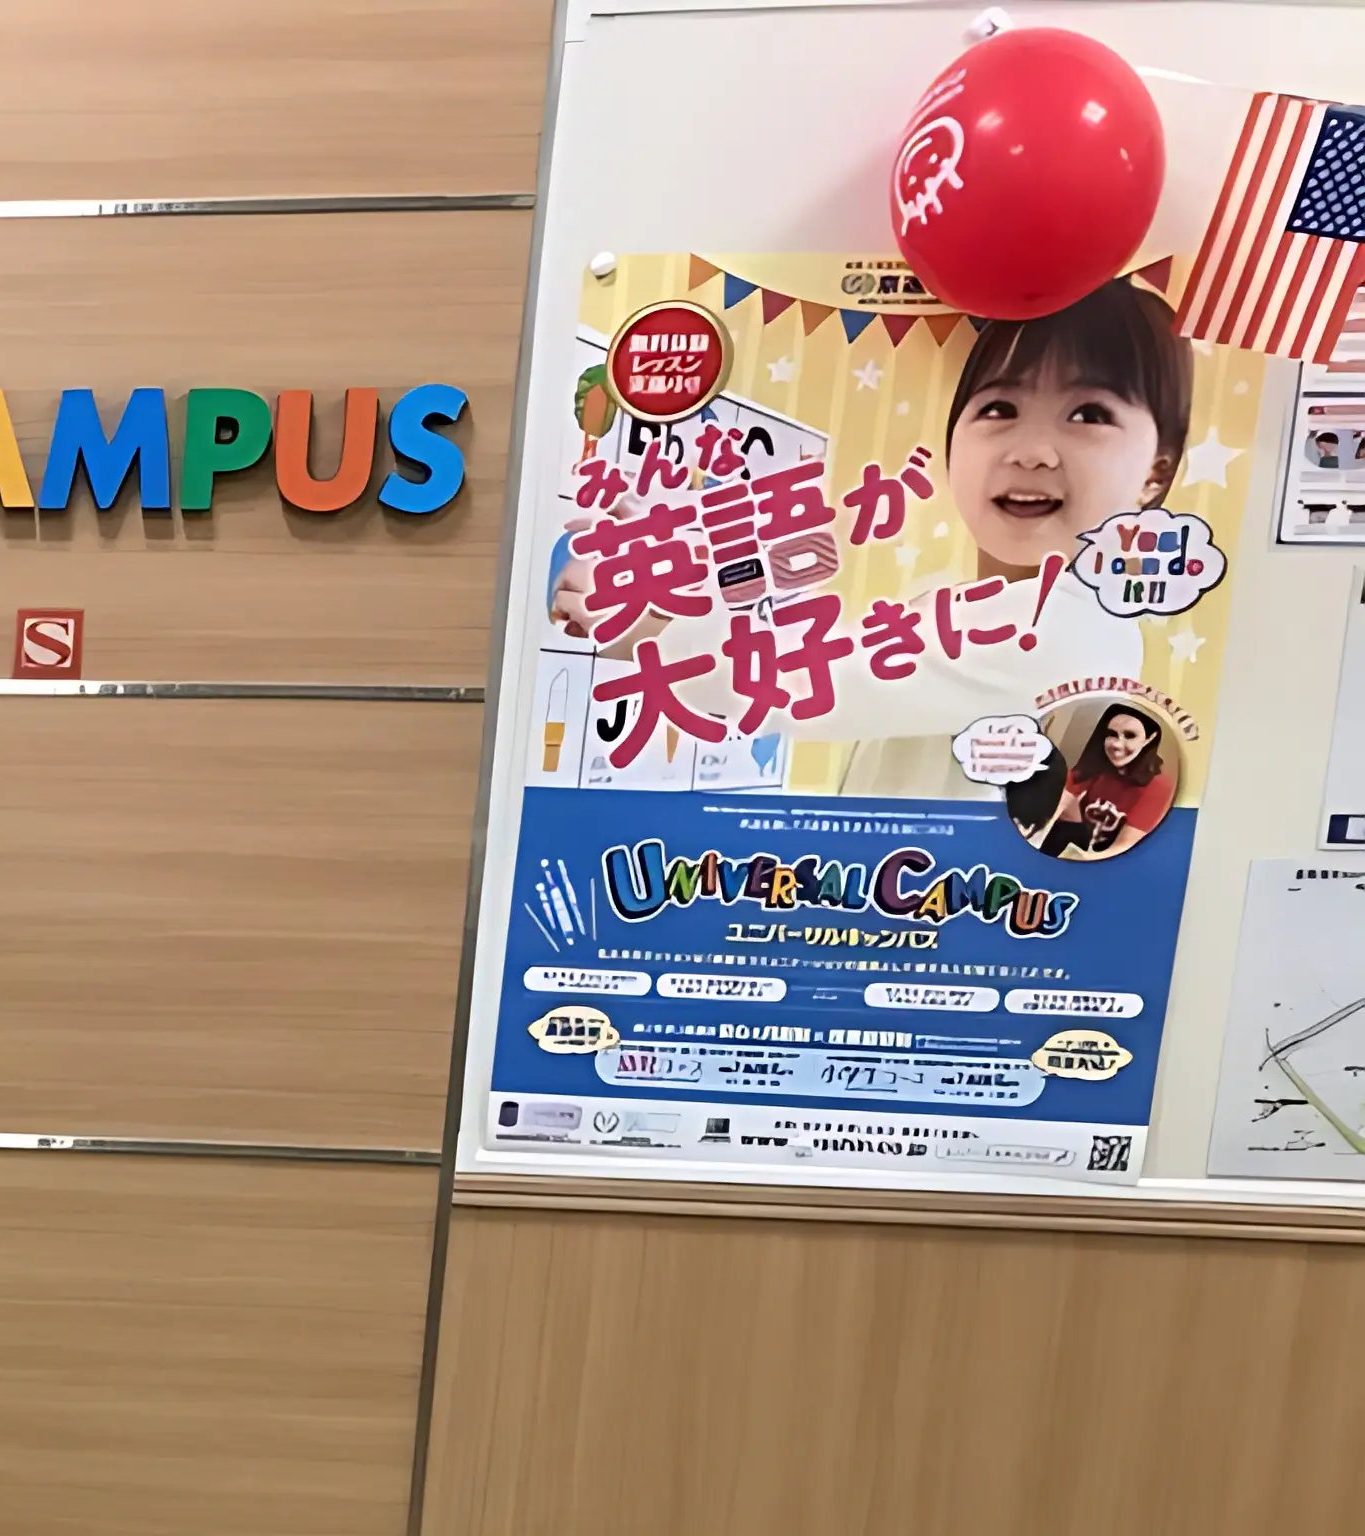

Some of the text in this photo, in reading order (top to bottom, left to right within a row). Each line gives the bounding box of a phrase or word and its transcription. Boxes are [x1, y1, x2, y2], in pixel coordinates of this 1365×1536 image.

[576, 424, 746, 508] みんな
[572, 446, 934, 644] 英語が
[592, 554, 1064, 770] 大好きに！
[604, 840, 1078, 939] UNIVERSAL CAMPUS
